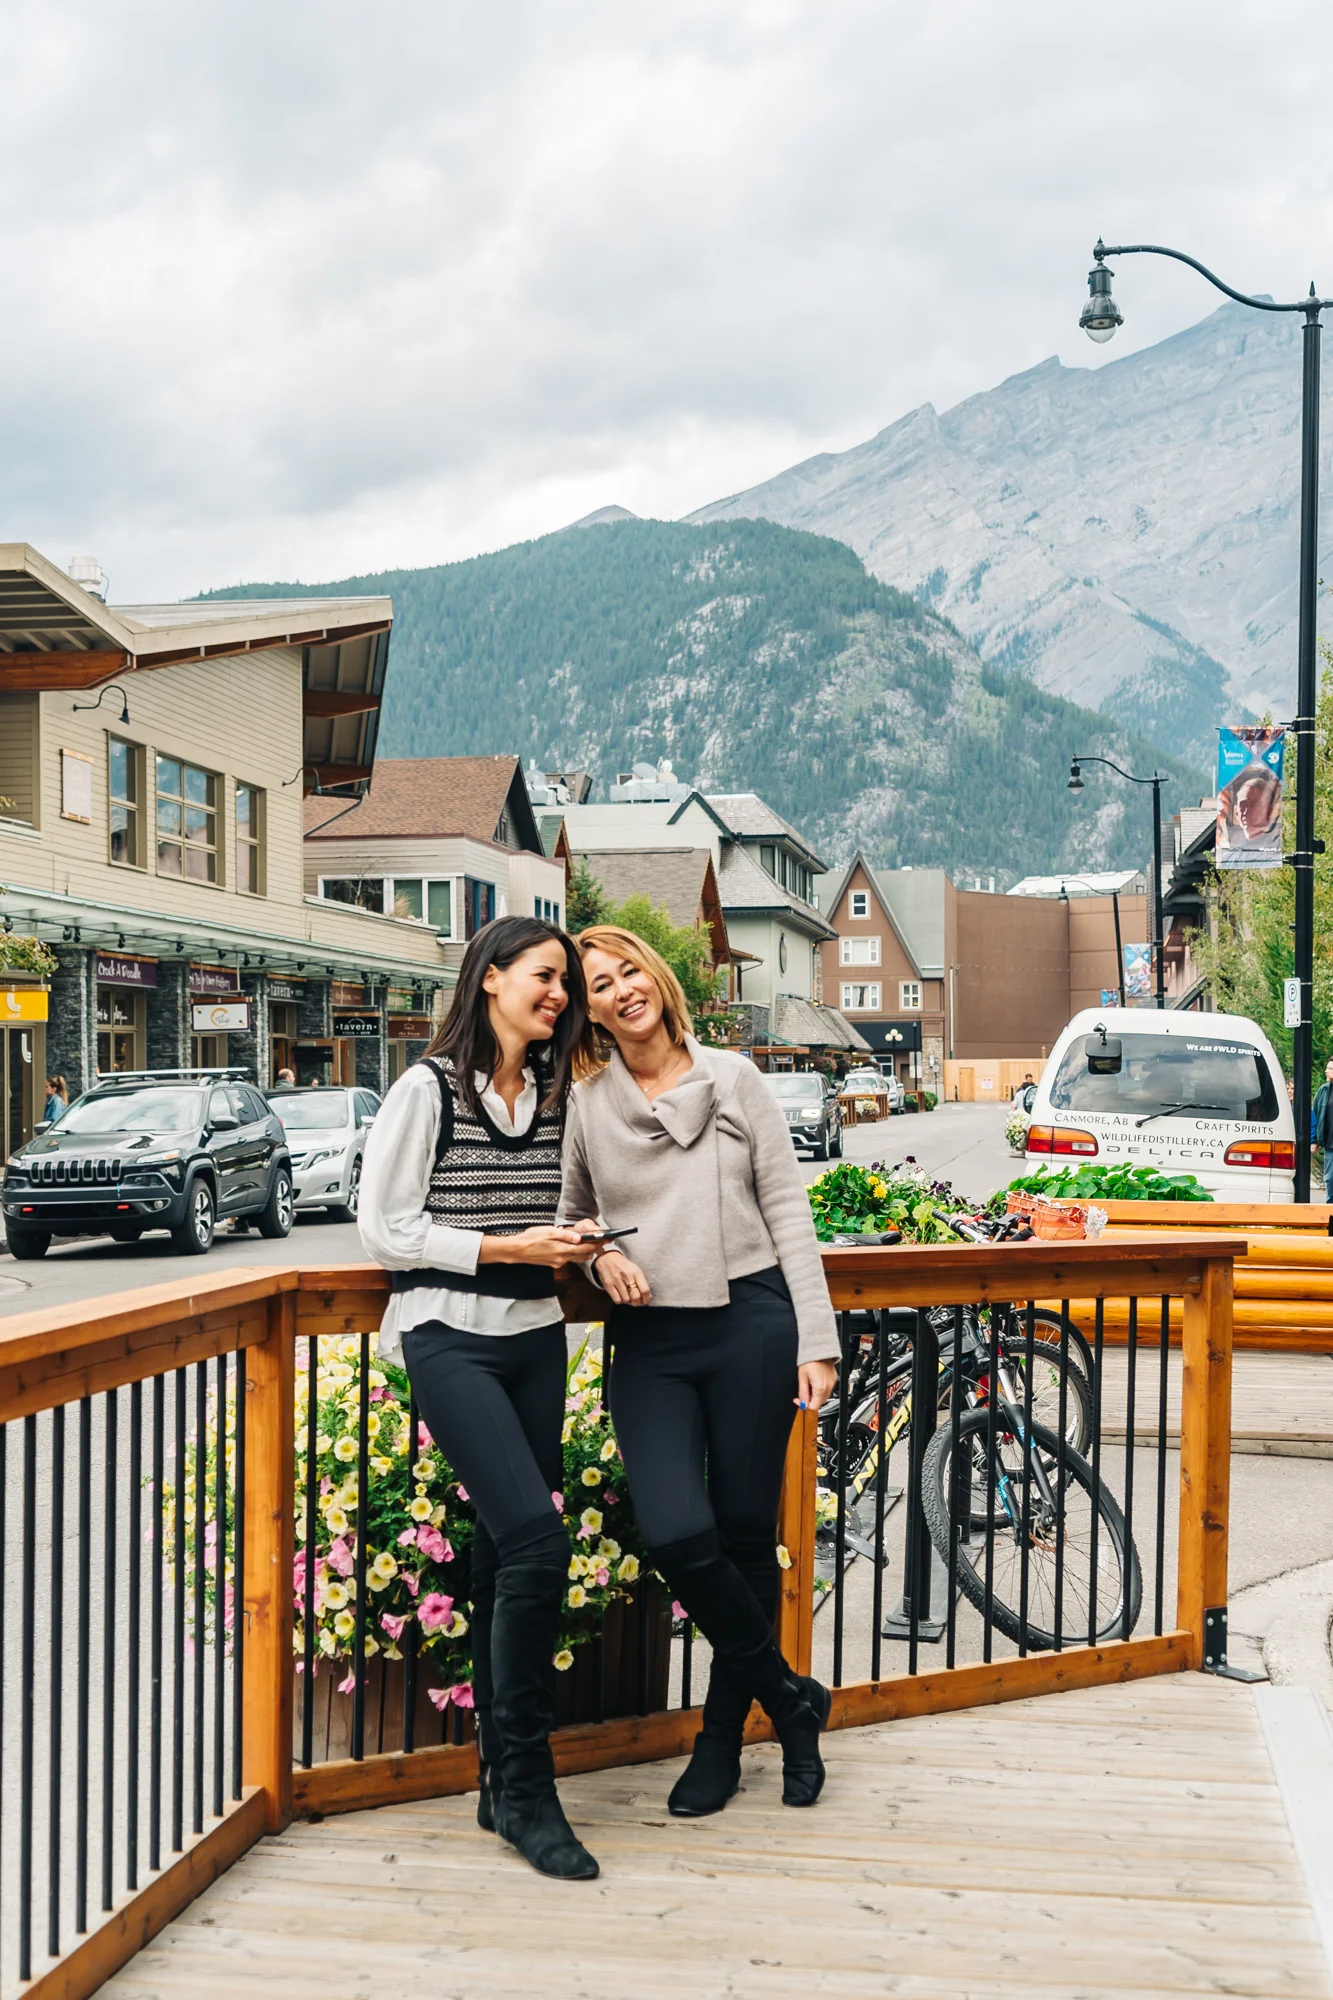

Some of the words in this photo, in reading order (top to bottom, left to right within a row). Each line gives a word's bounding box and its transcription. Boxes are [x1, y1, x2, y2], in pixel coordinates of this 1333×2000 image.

[270, 983, 291, 998] tavern
[340, 1023, 373, 1031] tavern
[1054, 1112, 1110, 1126] CANMORE,
[1195, 1120, 1231, 1132] CRAFT
[1234, 1123, 1274, 1136] SPIRITS
[1101, 1132, 1225, 1149] WILDLIFEDISTILLERY.CA
[1106, 1146, 1215, 1159] DELICA
